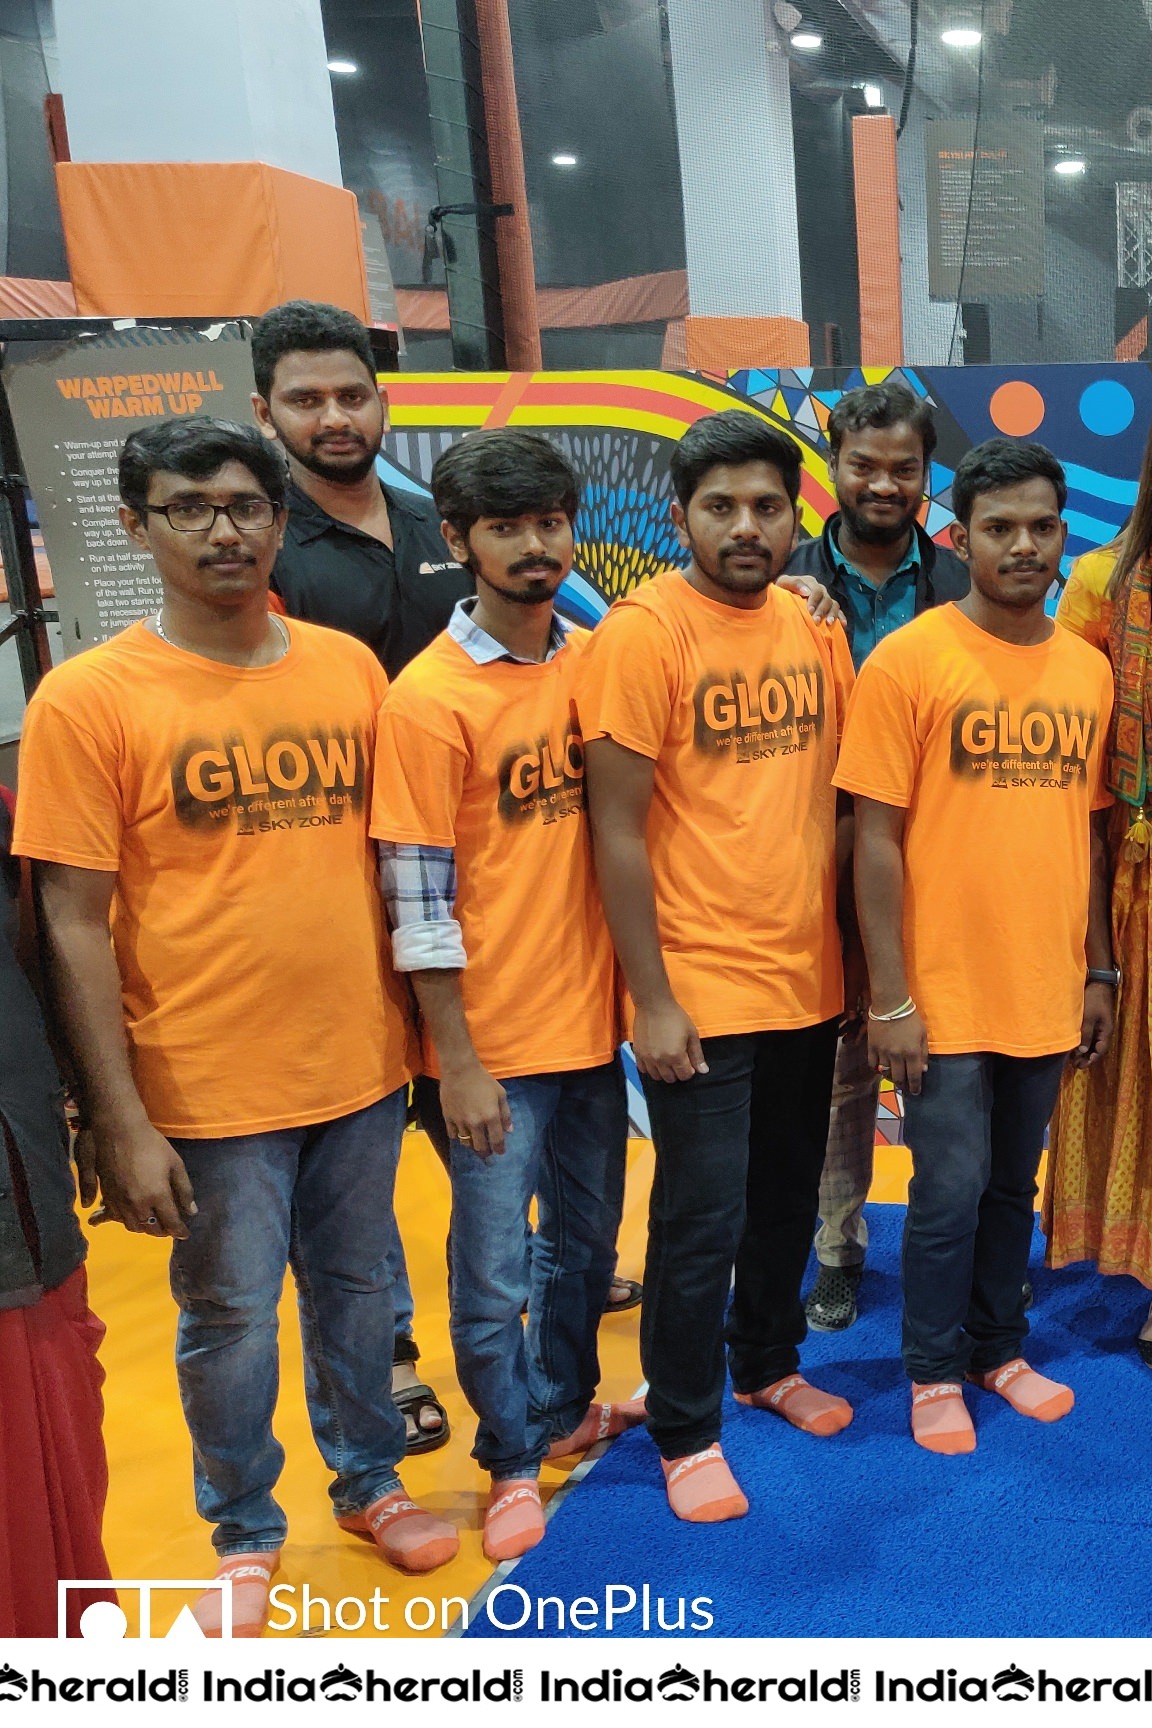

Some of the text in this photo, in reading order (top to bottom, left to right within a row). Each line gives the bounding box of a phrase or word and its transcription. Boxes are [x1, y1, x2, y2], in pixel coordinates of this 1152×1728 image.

[56, 370, 223, 399] WARPEDWALL
[87, 393, 203, 419] WARM UP
[63, 440, 102, 450] Warm-up
[103, 439, 119, 448] and
[65, 450, 117, 462] your attempt
[71, 468, 105, 478] Conquer
[72, 480, 90, 489] way
[91, 479, 102, 488] up
[103, 477, 112, 486] to
[76, 493, 120, 504] Start at the
[79, 504, 116, 514] and keep
[81, 518, 120, 528] Complete
[84, 529, 101, 539] way
[86, 538, 129, 548] back down
[88, 554, 105, 563] Run
[107, 553, 116, 562] at
[116, 552, 131, 561] half
[91, 562, 145, 573] on this activity
[93, 579, 116, 587] Place
[116, 578, 134, 588] your
[135, 577, 151, 586] first
[95, 589, 104, 598] of
[104, 588, 118, 597] the
[137, 587, 155, 596] Run
[97, 599, 114, 608] take
[115, 598, 130, 607] two
[98, 606, 158, 618] as necessary to
[100, 620, 109, 628] or
[704, 673, 818, 731] GLOW
[716, 734, 743, 747] we're
[744, 730, 779, 744] different
[799, 721, 816, 733] dark
[961, 710, 1092, 760] GLOW
[752, 741, 808, 761] SKY ZONE
[186, 738, 356, 802] GLOW
[510, 734, 584, 799] GLO
[971, 759, 999, 771] we're
[1001, 758, 1041, 771] different
[1062, 763, 1082, 775] dark
[1011, 777, 1070, 790] SKY ZONE
[209, 803, 245, 819] we're
[299, 794, 325, 808] afte
[329, 793, 352, 806] dark
[258, 814, 343, 833] SKY ZONE
